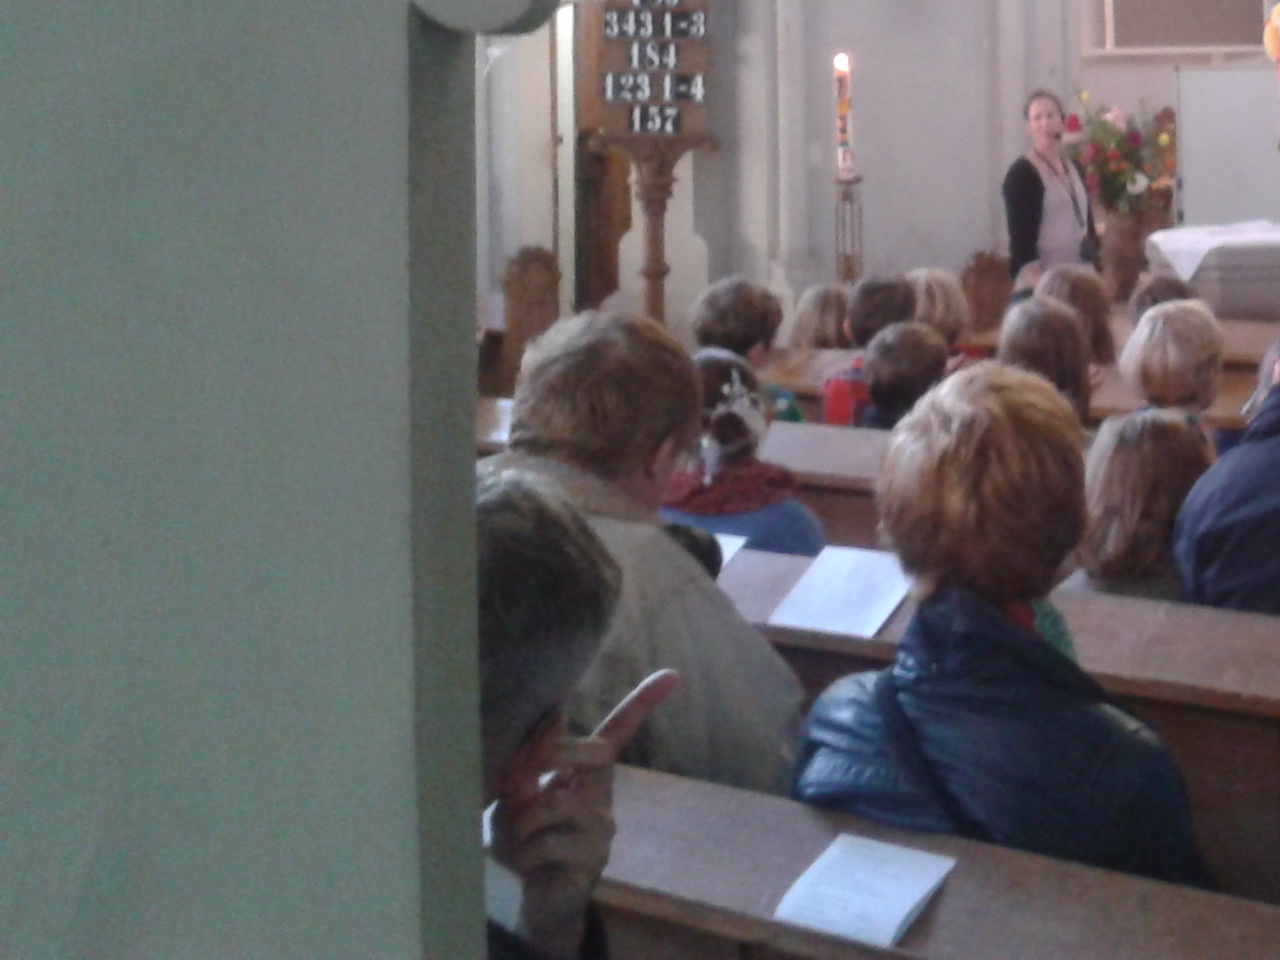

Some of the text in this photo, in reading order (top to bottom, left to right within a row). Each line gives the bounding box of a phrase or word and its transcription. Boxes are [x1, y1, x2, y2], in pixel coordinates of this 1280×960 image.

[605, 10, 705, 38] 343 1-3
[631, 41, 676, 69] 184
[605, 72, 704, 102] 123 1-4
[632, 104, 678, 134] 157
